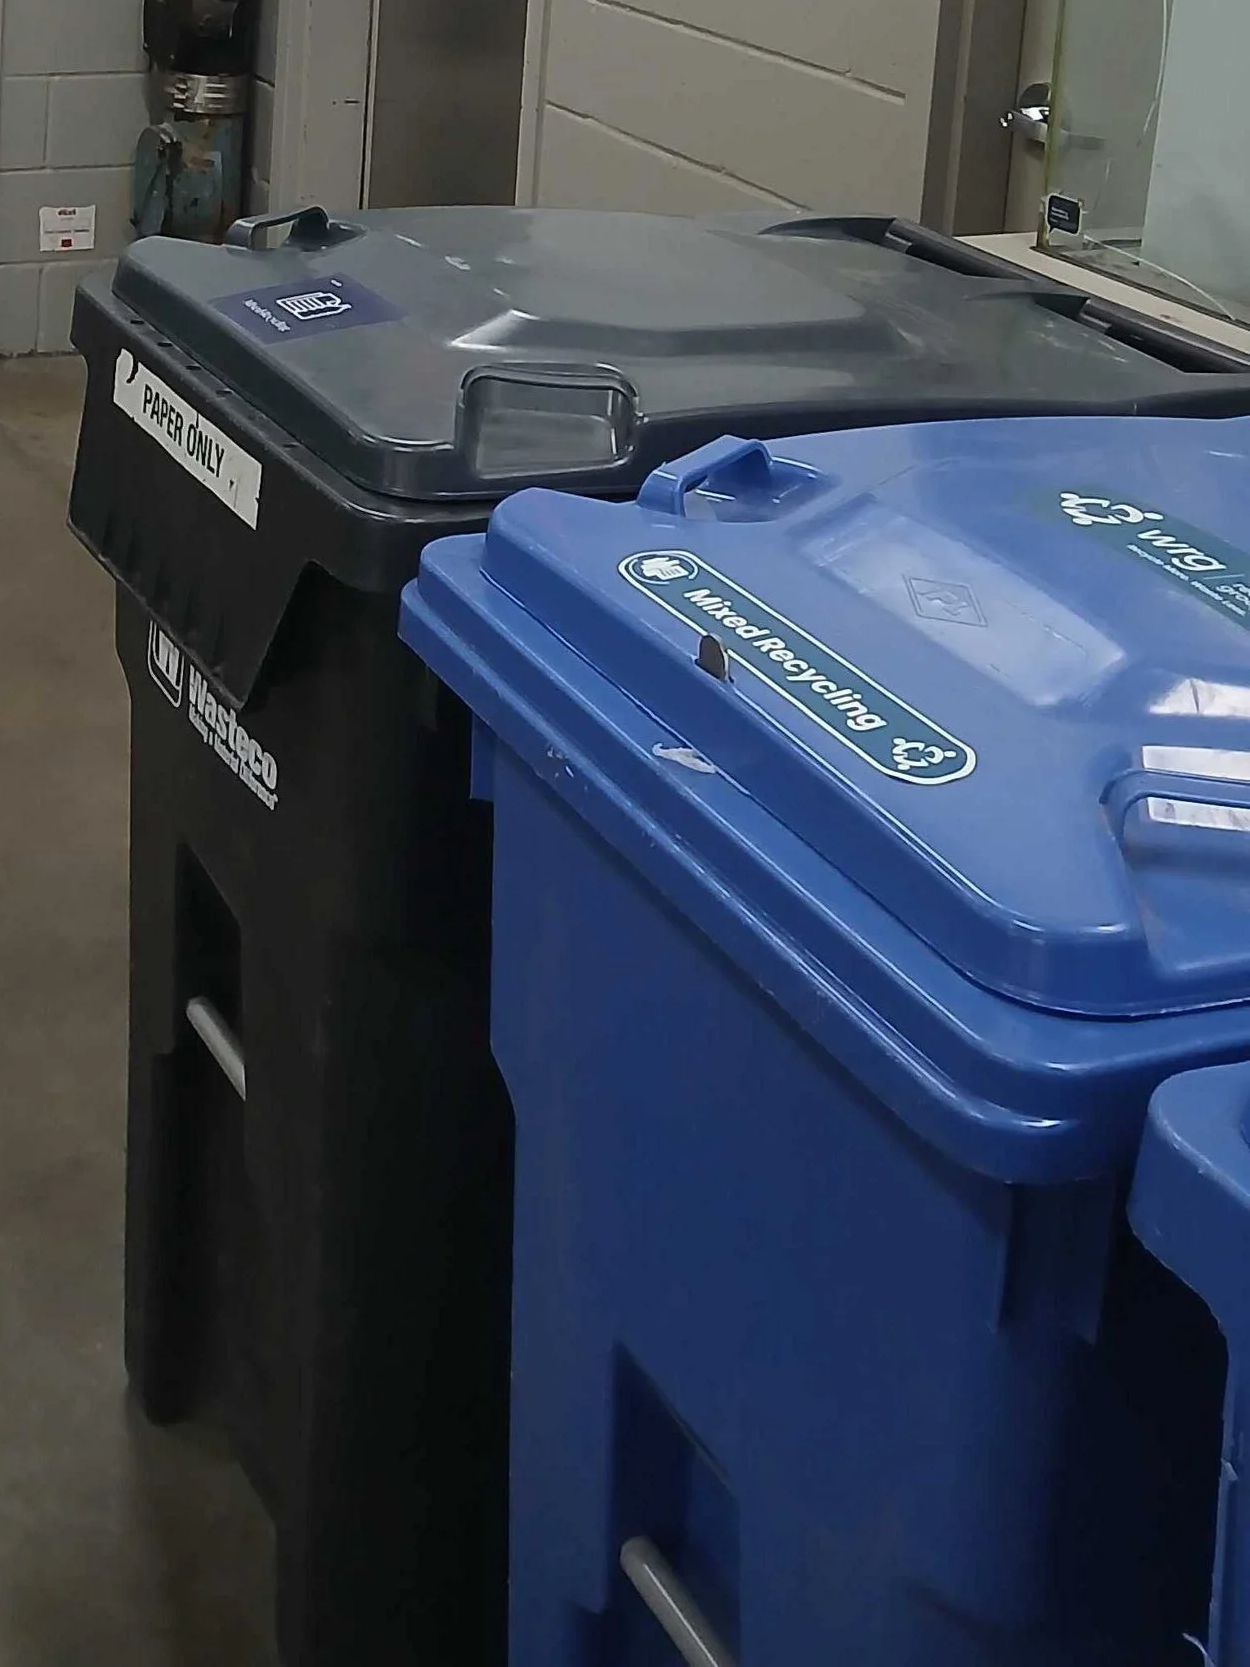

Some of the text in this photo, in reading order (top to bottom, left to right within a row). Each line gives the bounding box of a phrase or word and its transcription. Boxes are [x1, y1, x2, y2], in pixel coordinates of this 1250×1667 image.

[143, 384, 225, 478] PAPER ONLY
[1137, 529, 1227, 571] wrg
[683, 588, 888, 731] Mixed Recycling
[188, 664, 278, 790] Wasteco
